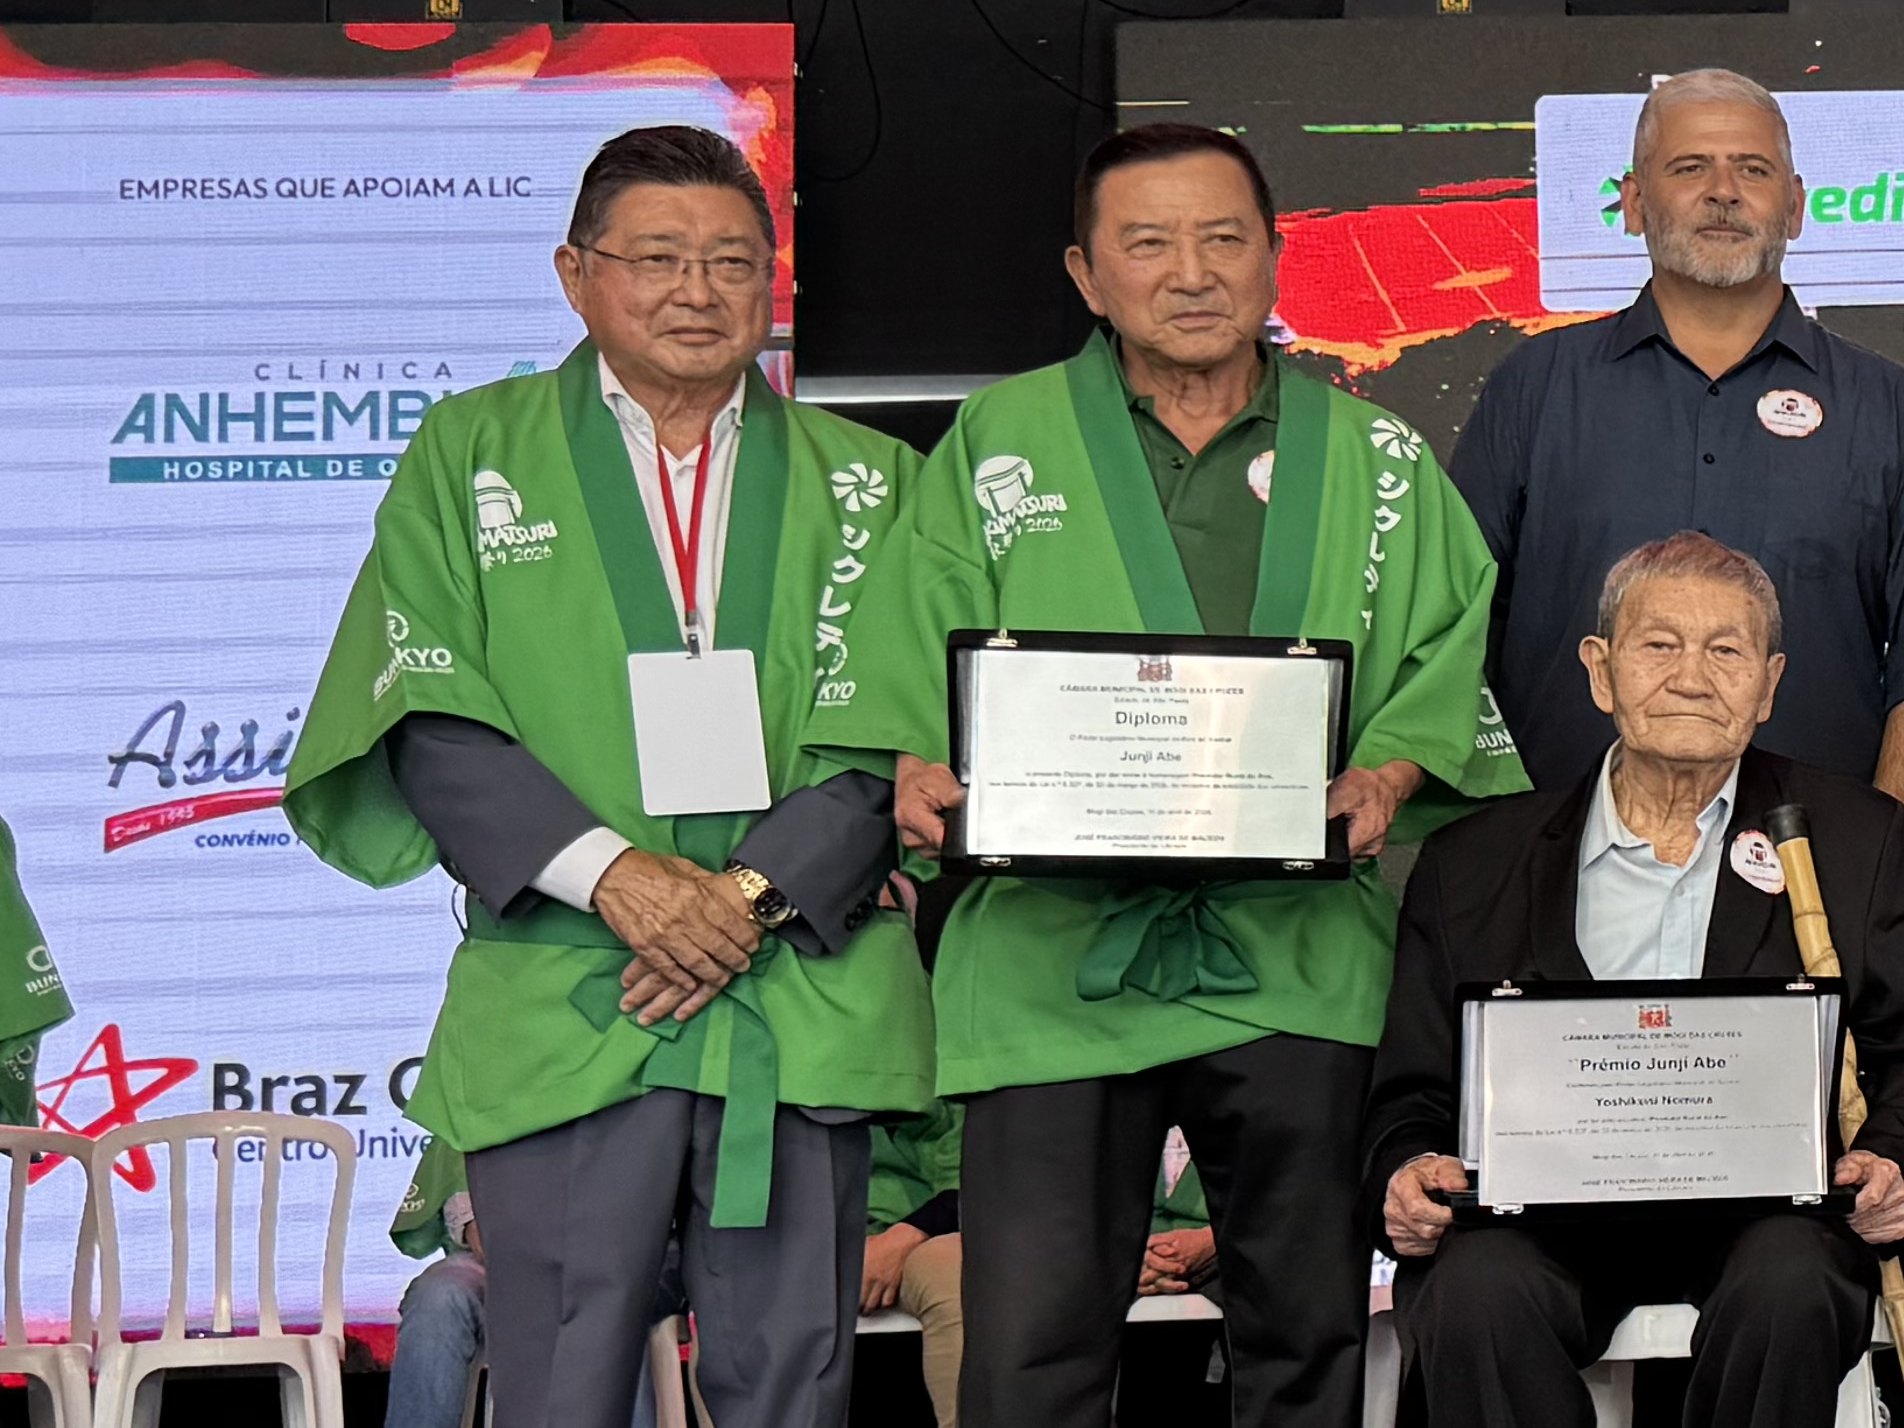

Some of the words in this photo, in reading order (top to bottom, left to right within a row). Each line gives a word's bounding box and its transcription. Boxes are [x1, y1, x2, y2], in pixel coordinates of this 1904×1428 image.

[119, 178, 268, 199] EMPRESAS
[275, 178, 336, 199] QUE
[342, 177, 456, 198] APOIAM
[463, 177, 482, 197] A
[489, 176, 532, 197] LIC
[254, 359, 453, 381] CLÍNICA
[110, 389, 453, 444] ANHEMB
[163, 459, 312, 481] HOSPITAL
[325, 459, 364, 477] DE
[512, 545, 553, 563] 2026
[818, 680, 857, 701] KYO
[1115, 712, 1188, 727] Diploma
[107, 699, 300, 789] Assi
[1475, 728, 1514, 750] BUN
[1120, 751, 1153, 764] Junji
[1157, 751, 1182, 762] Abe
[1646, 1056, 1689, 1073] Junji
[212, 1062, 368, 1116] Braz
